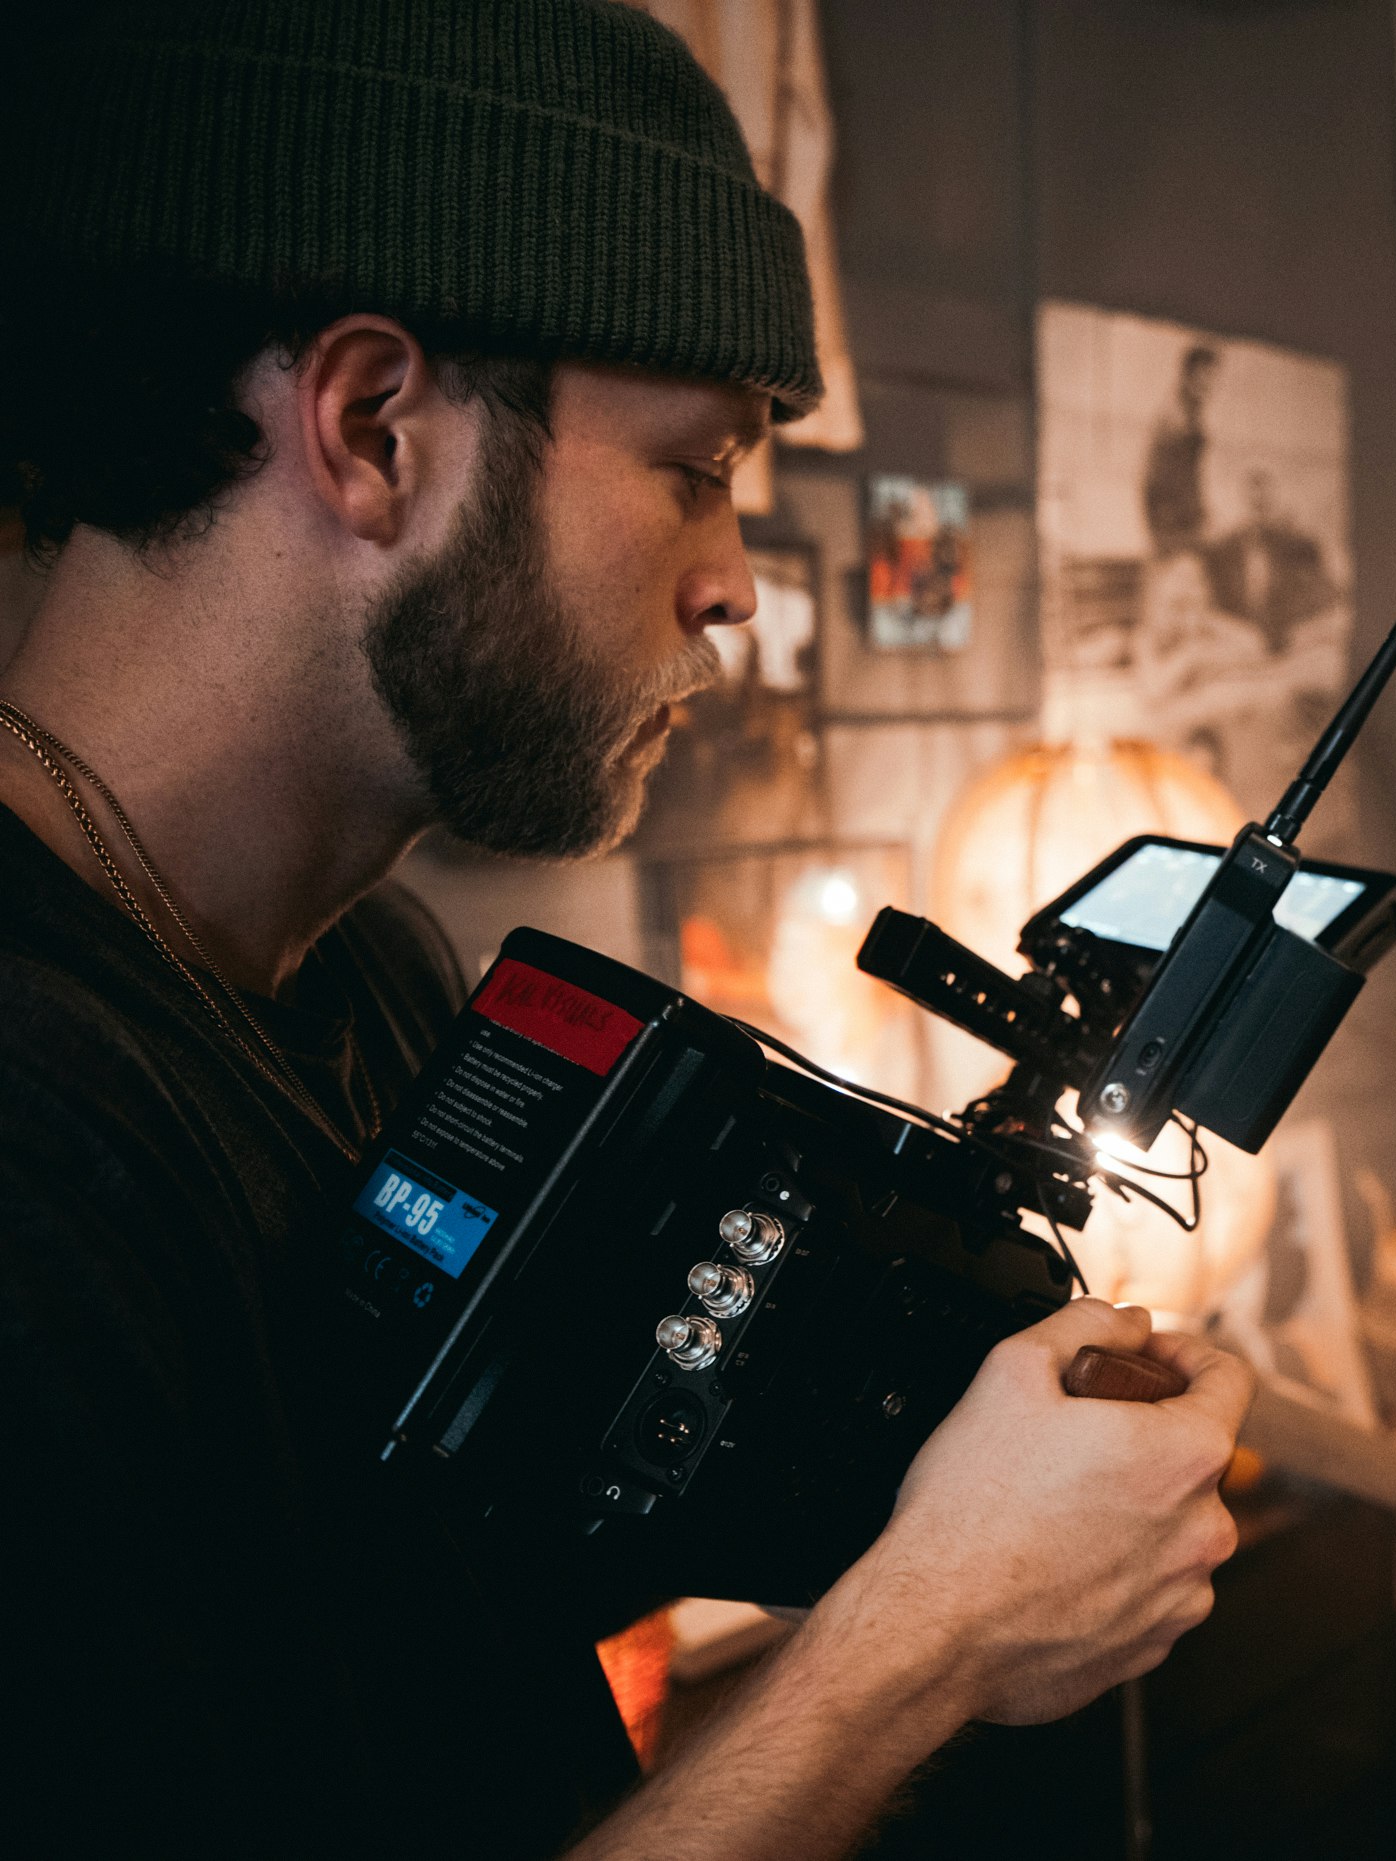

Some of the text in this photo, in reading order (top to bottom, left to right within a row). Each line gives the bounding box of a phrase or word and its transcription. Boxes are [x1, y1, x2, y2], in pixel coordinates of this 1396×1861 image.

[1251, 857, 1268, 873] TX
[463, 1053, 482, 1068] Battery
[481, 1064, 495, 1074] must
[493, 1069, 501, 1077] be
[500, 1073, 523, 1088] recycled
[472, 1041, 483, 1050] Use
[482, 1047, 494, 1057] only
[493, 1052, 529, 1074] recommended
[446, 1078, 455, 1088] Do
[454, 1084, 464, 1092] not
[462, 1088, 493, 1108] disassemble
[455, 1065, 463, 1075] Do
[462, 1071, 473, 1079] not
[471, 1075, 491, 1089] dispose
[495, 1089, 511, 1099] water
[438, 1091, 446, 1100] Do
[445, 1097, 455, 1105] not
[453, 1101, 472, 1115] subject
[470, 1110, 477, 1118] to
[420, 1117, 429, 1126] Do
[428, 1122, 438, 1131] not
[436, 1128, 455, 1141] expose
[459, 1140, 489, 1162] temperature
[488, 1158, 505, 1171] above
[429, 1104, 438, 1113] Do
[437, 1110, 447, 1118] not
[444, 1114, 475, 1134] short-circuit
[473, 1130, 482, 1139] the
[481, 1135, 500, 1150] battery
[373, 1173, 444, 1235] BP-95
